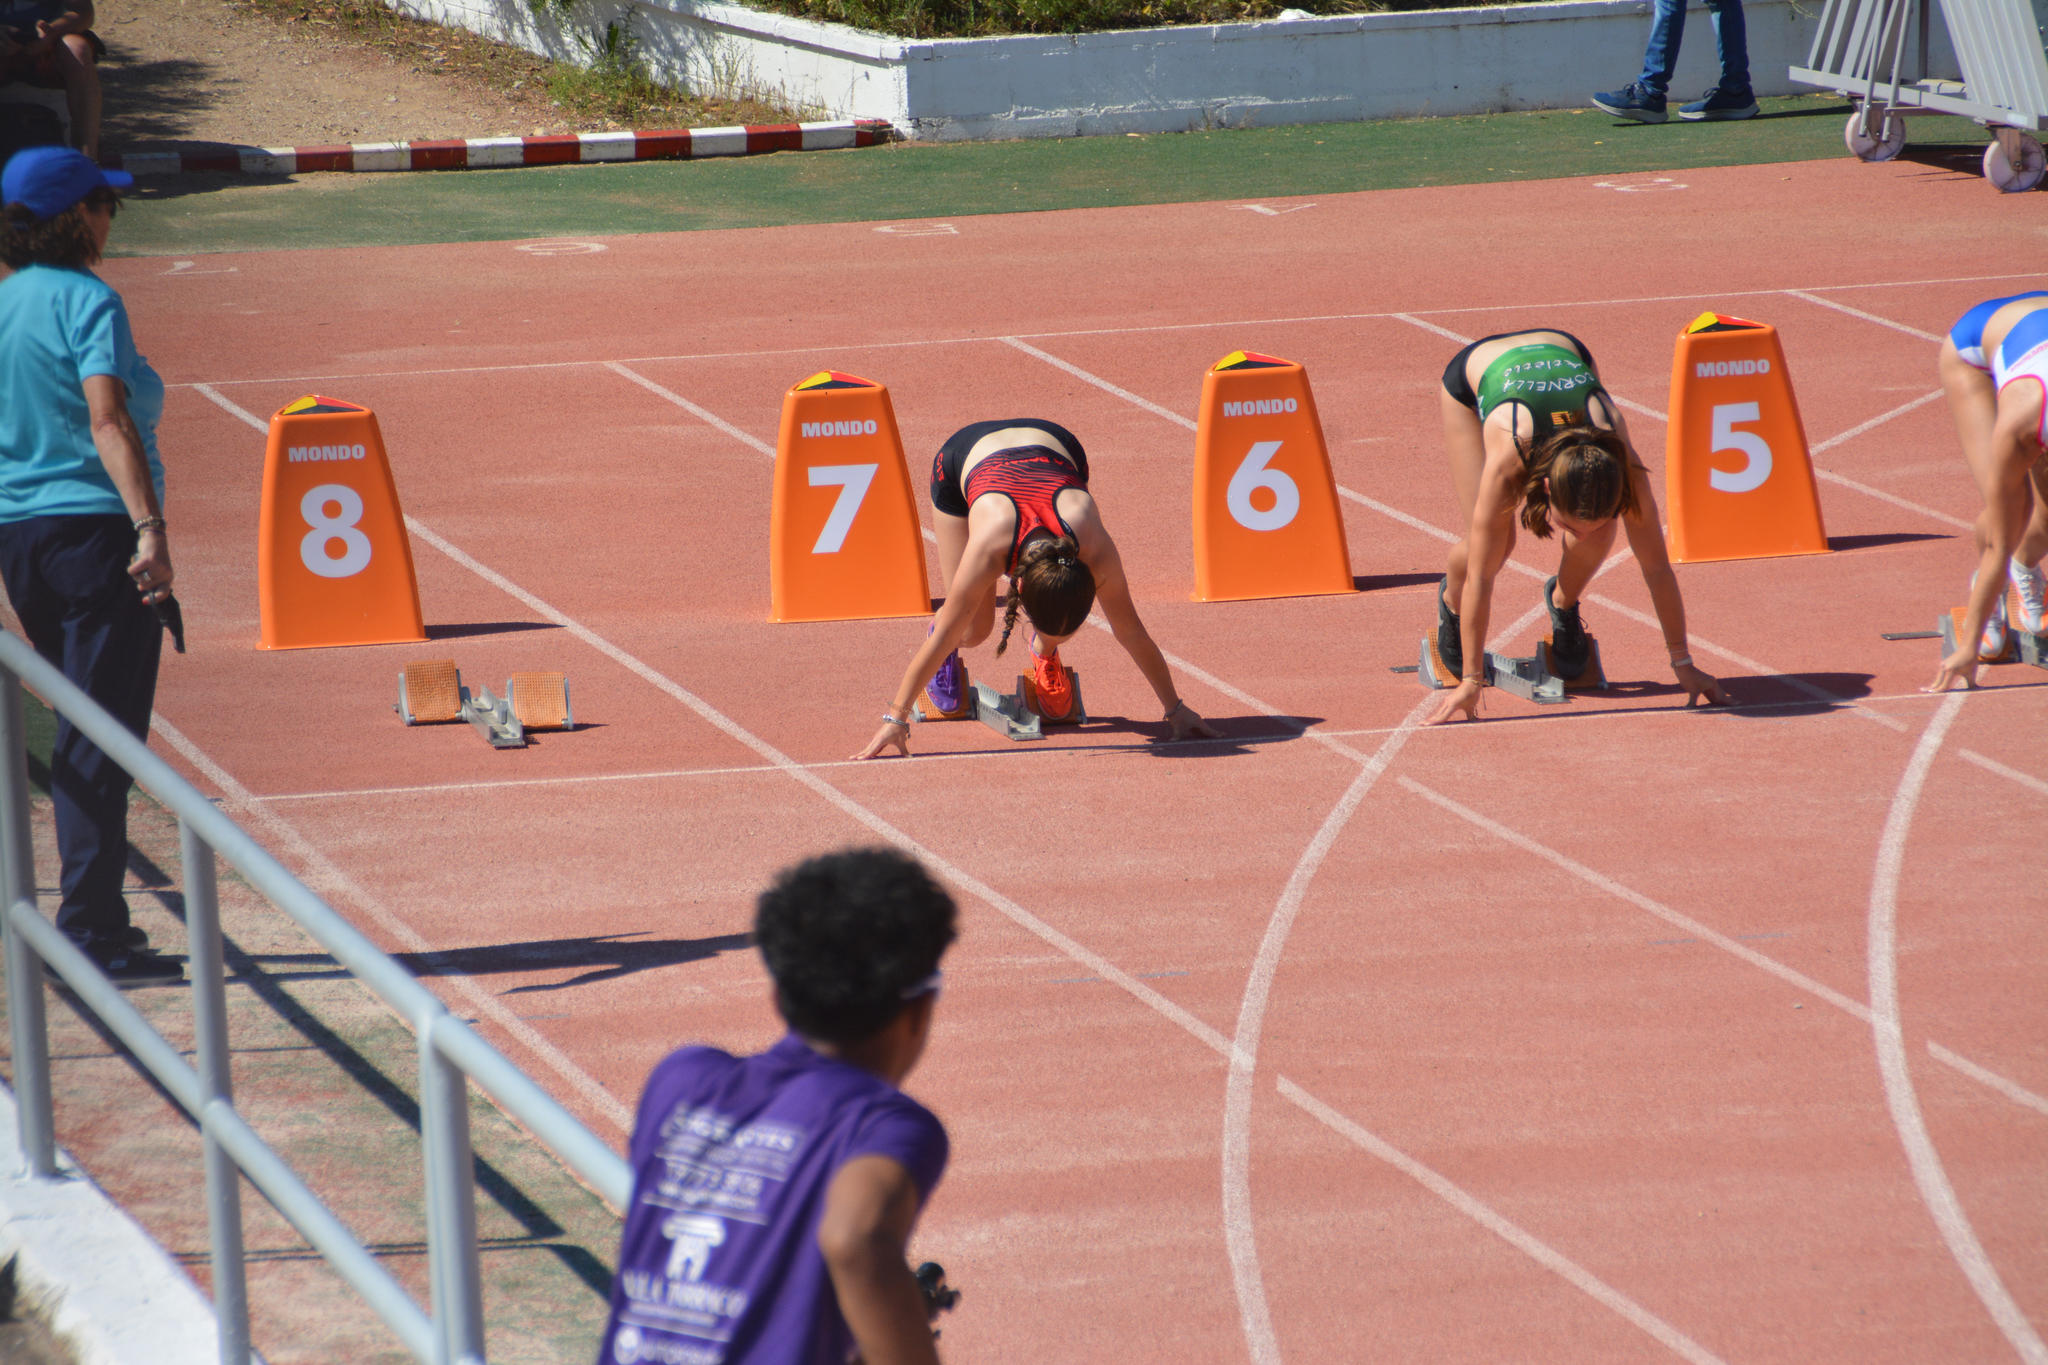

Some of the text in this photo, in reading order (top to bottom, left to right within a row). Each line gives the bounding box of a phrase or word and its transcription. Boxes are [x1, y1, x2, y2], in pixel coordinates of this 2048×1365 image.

[1696, 359, 1770, 378] MONDO
[801, 419, 877, 438] MONDO
[1224, 398, 1298, 417] MONDO
[288, 444, 366, 463] MONDO
[1710, 401, 1773, 493] 5
[808, 463, 879, 554] 7
[1227, 440, 1300, 531] 6
[300, 483, 372, 578] 8
